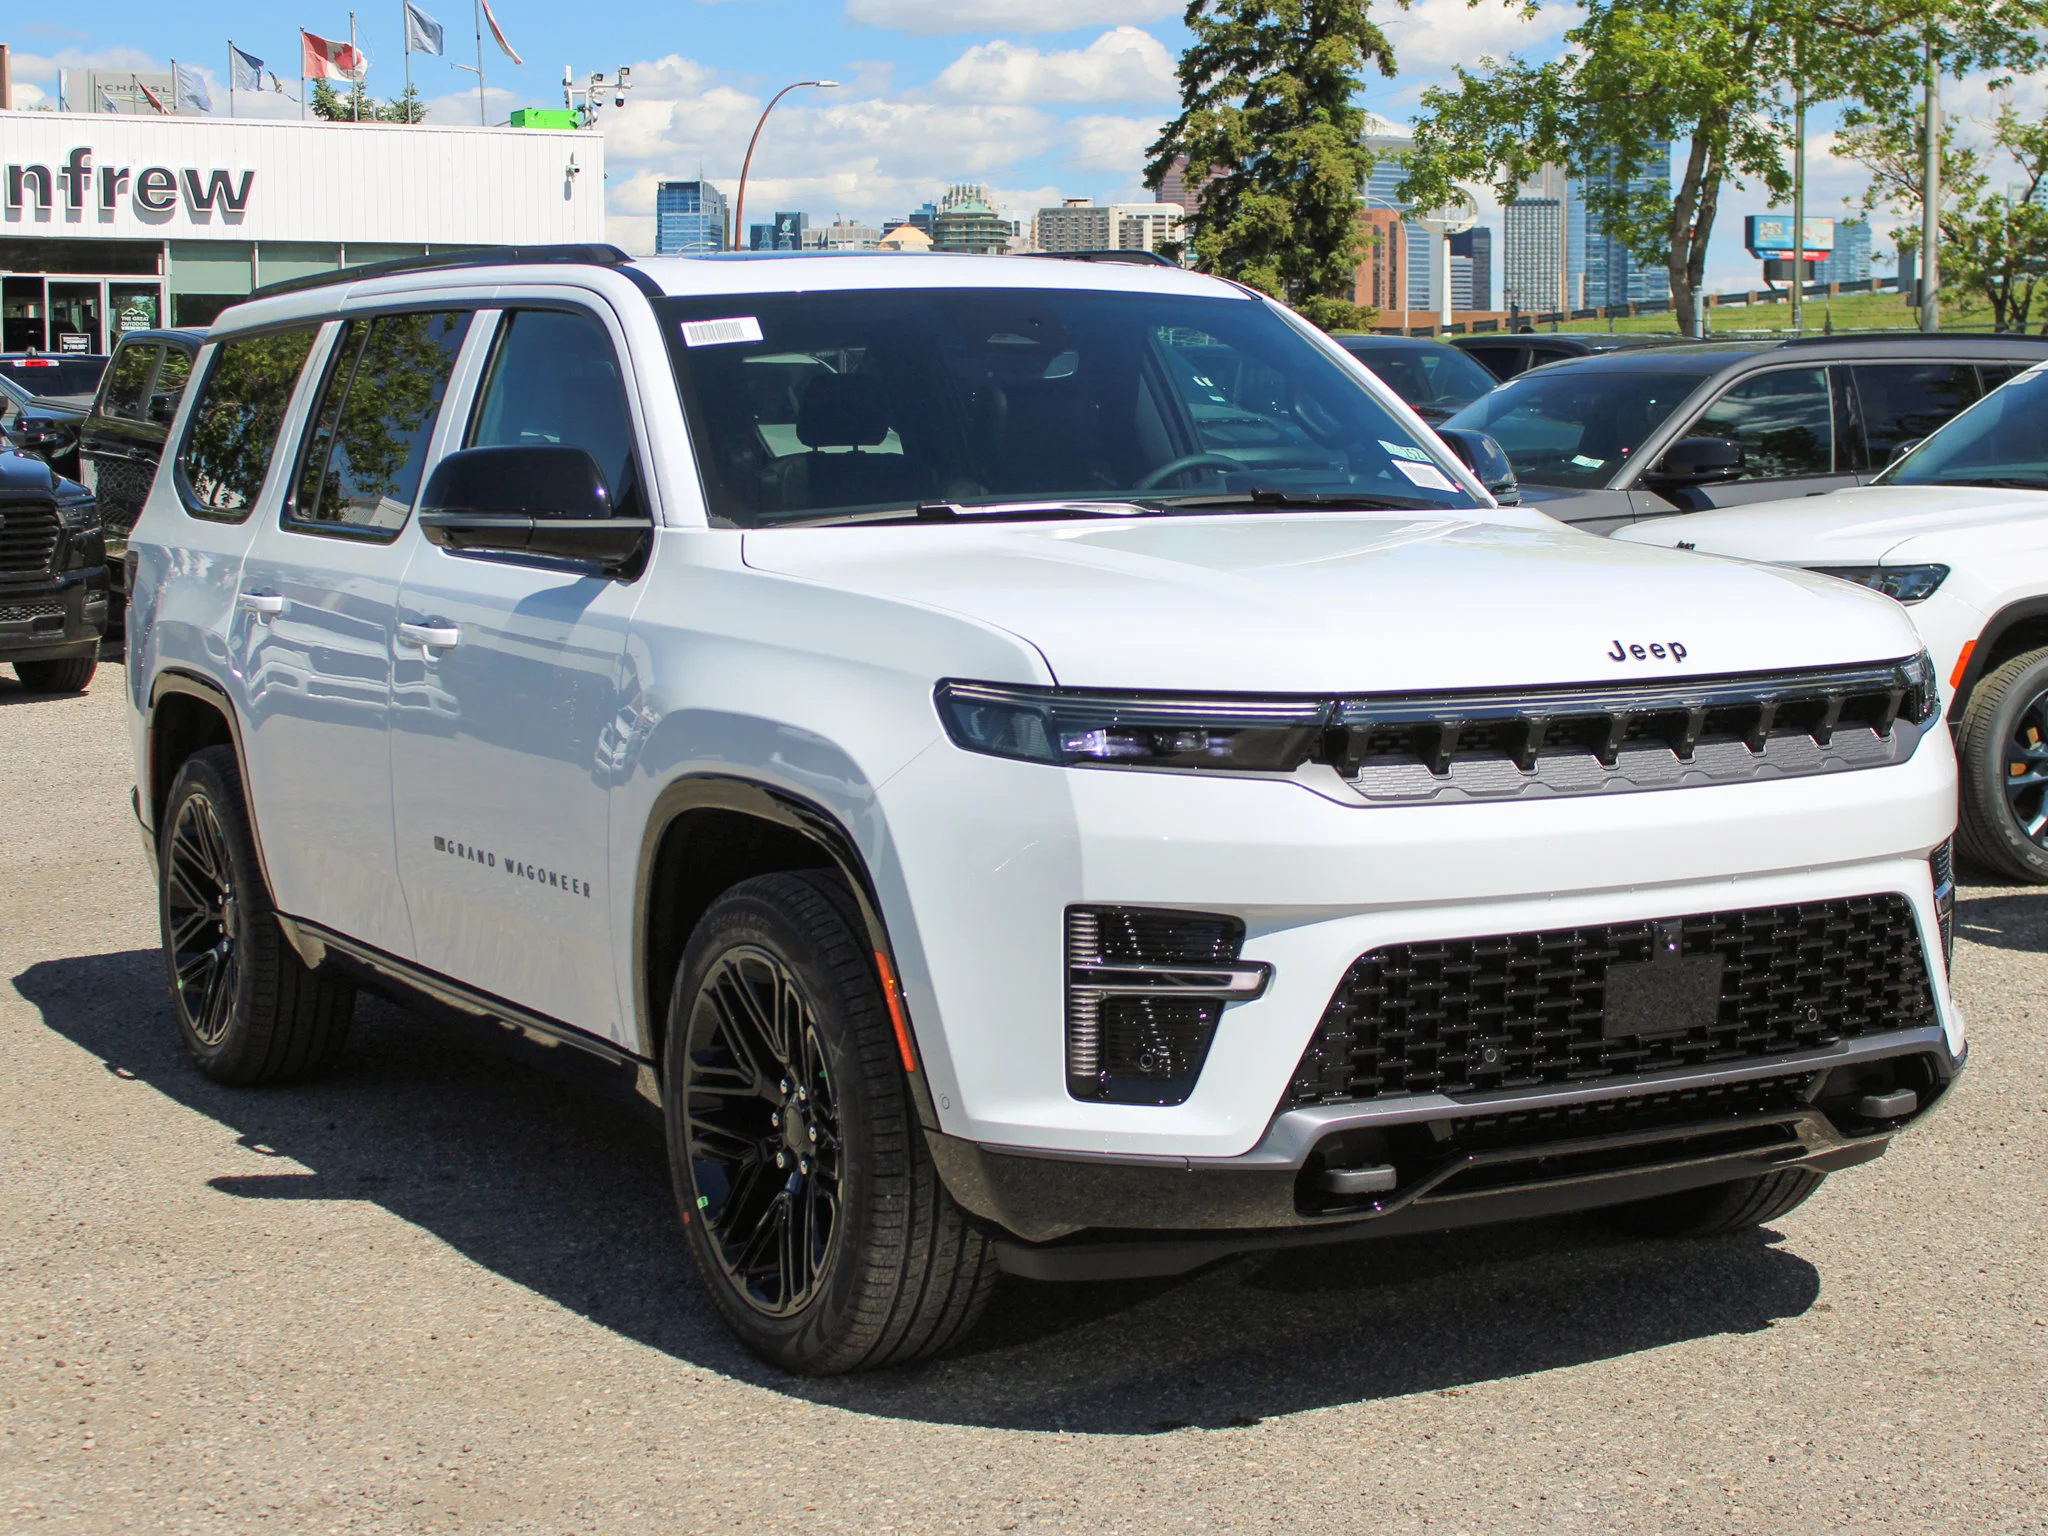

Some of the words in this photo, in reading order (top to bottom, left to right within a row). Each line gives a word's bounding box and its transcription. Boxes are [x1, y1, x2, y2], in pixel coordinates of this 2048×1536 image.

[104, 84, 171, 93] CHRSL
[6, 147, 255, 211] nfrew
[1607, 640, 1687, 663] Jeep
[447, 840, 496, 867] GRAND
[504, 857, 591, 898] WAGONEER
